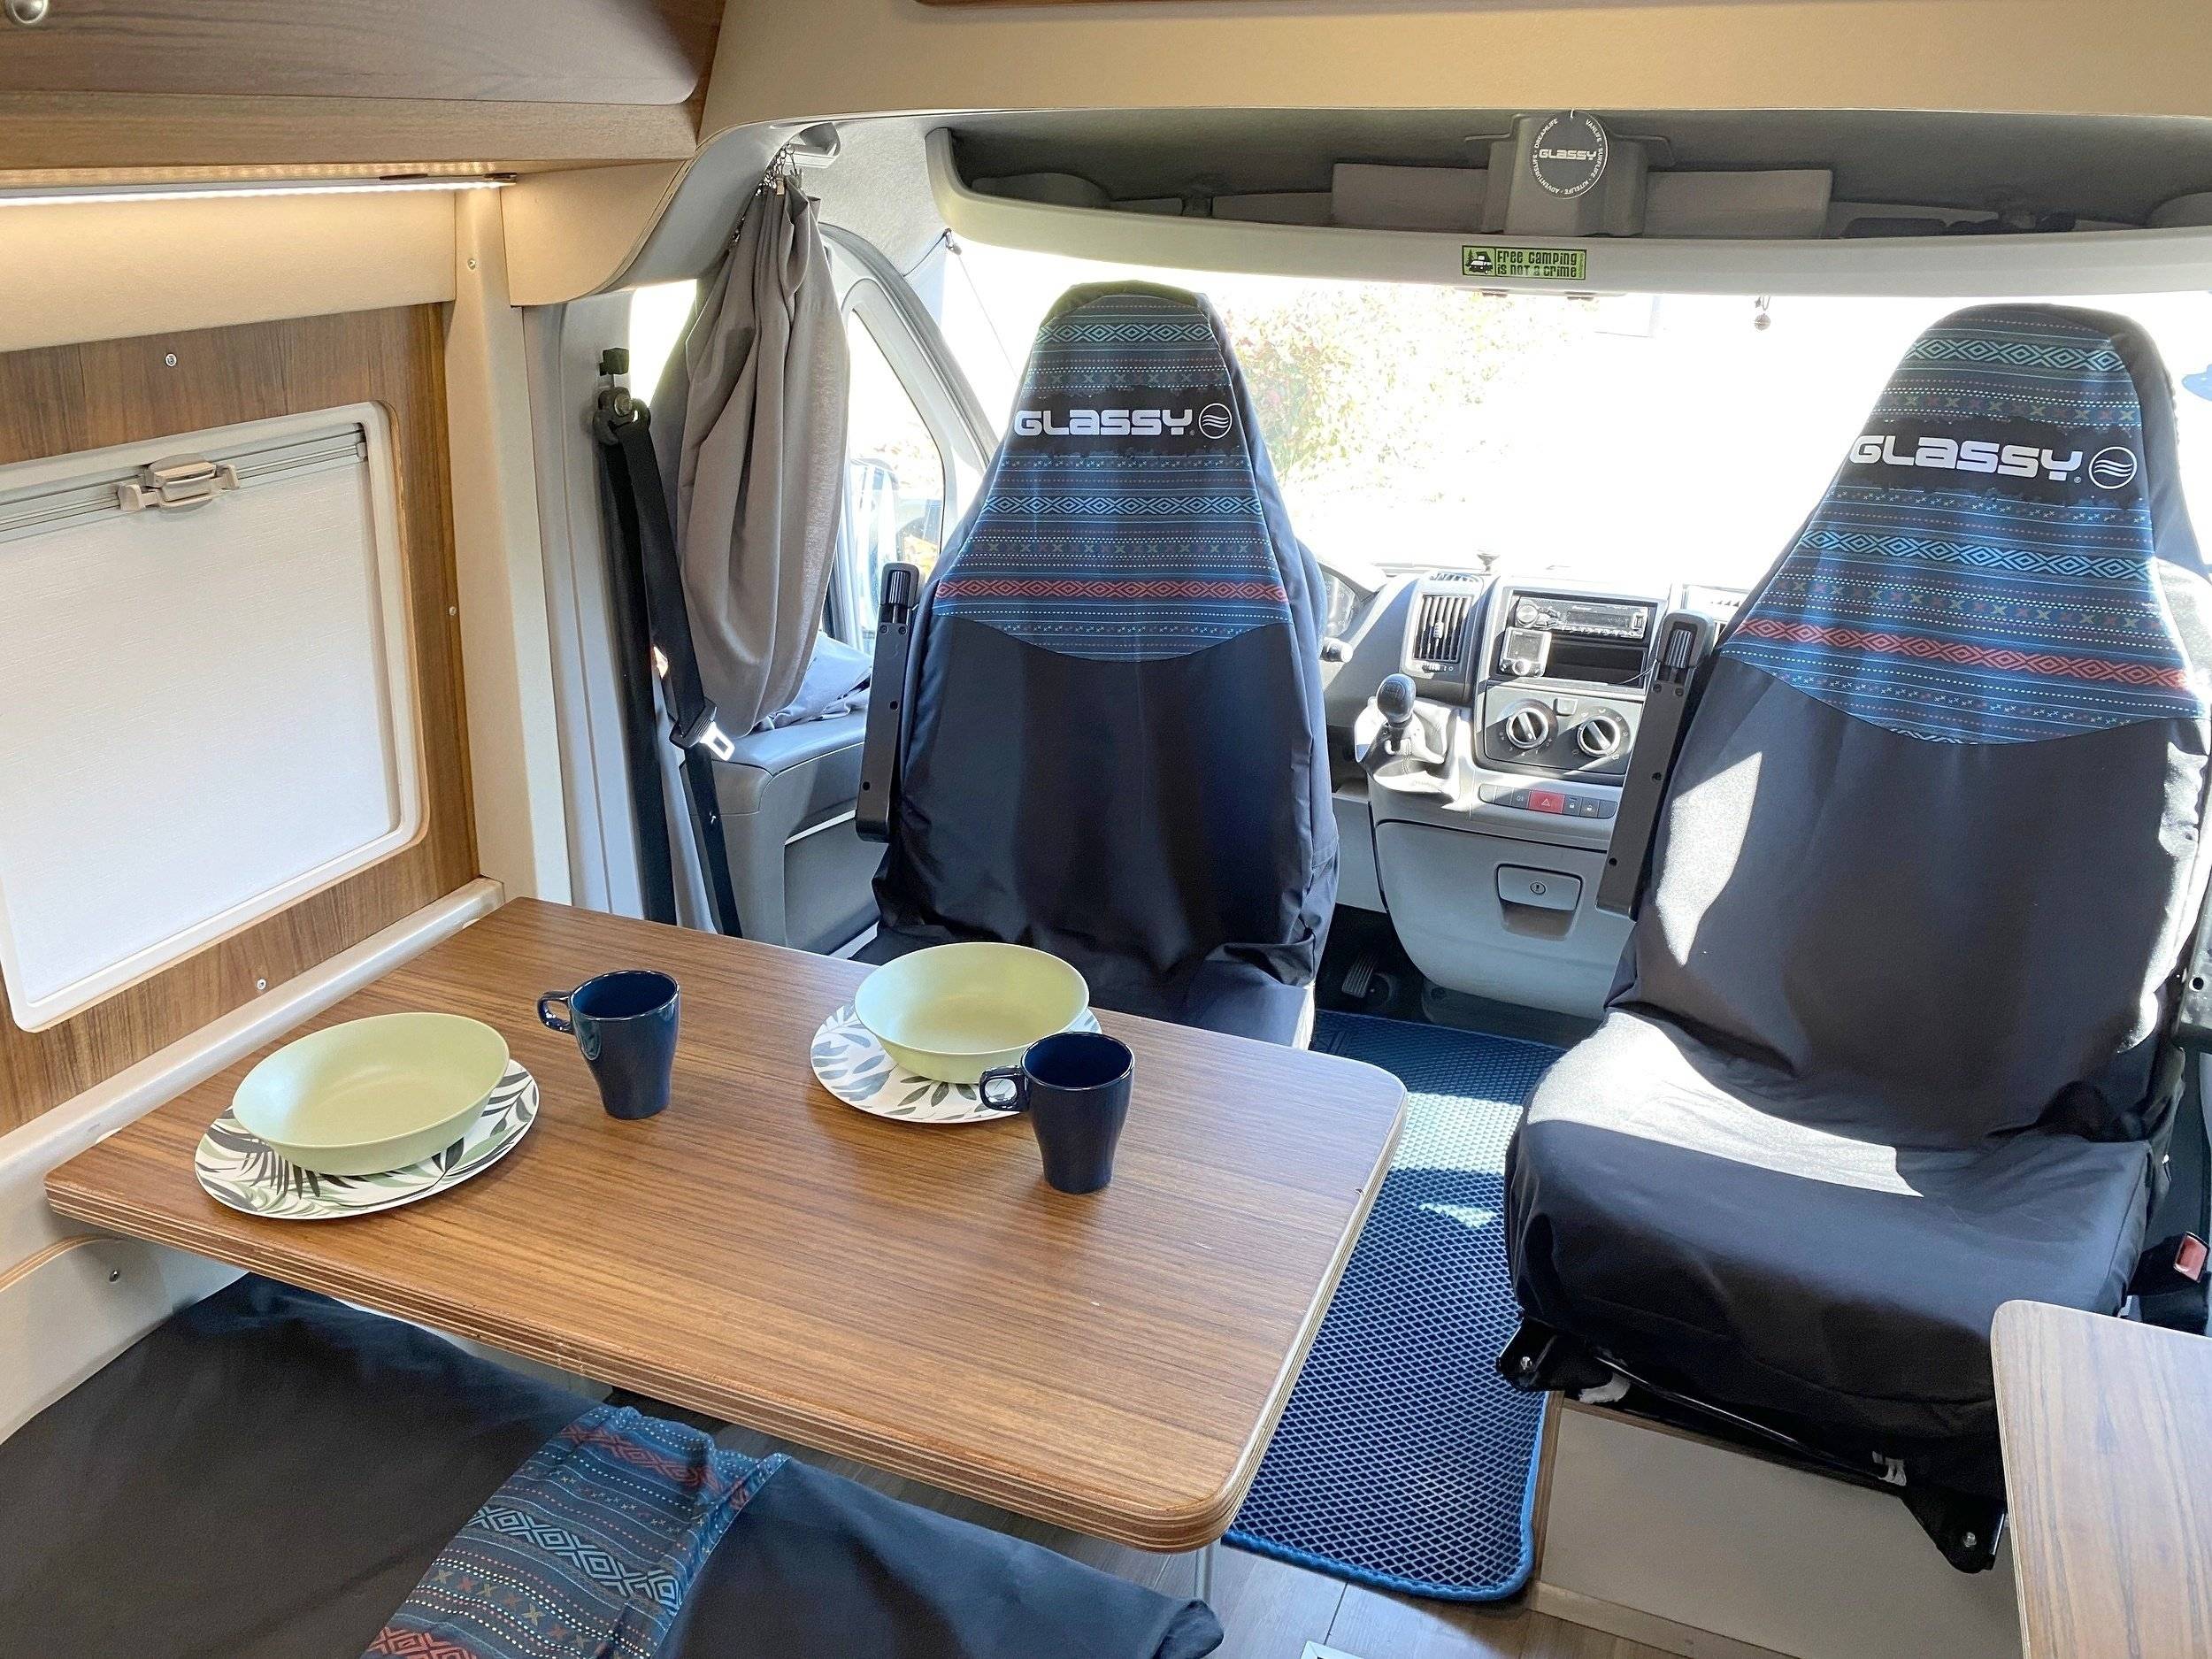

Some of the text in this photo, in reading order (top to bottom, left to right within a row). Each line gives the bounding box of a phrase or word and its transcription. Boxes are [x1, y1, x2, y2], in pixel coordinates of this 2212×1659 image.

[1533, 118, 1558, 149] DREAMLIFE
[1586, 119, 1602, 142] VANLIFE
[1532, 154, 1560, 194] ADVENTURELIFE
[1590, 147, 1604, 178] SURFLIFE
[1497, 264, 1507, 275] is
[1533, 265, 1540, 276] a
[1543, 265, 1578, 278] crime
[1529, 252, 1578, 265] camping
